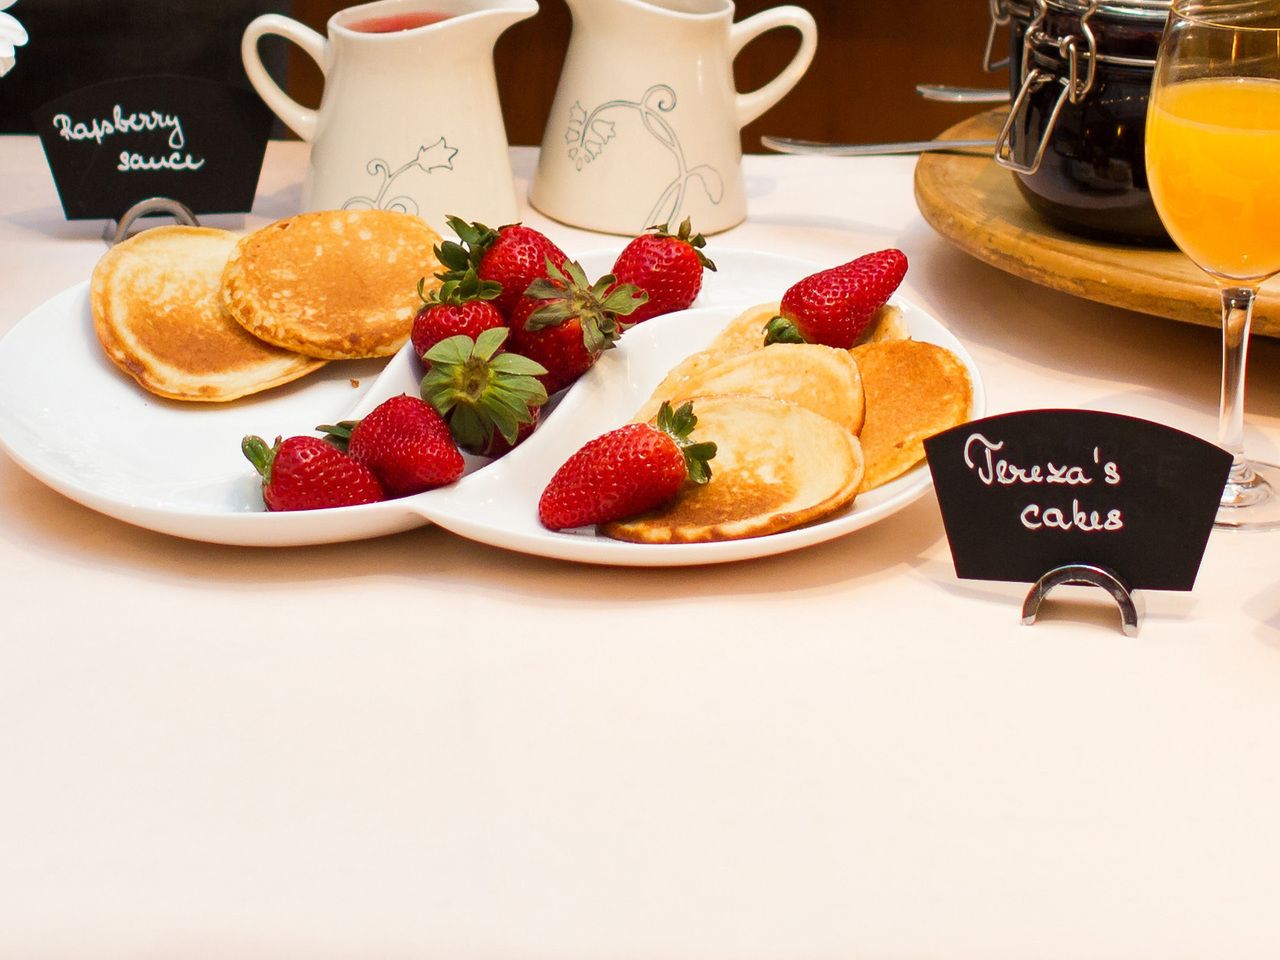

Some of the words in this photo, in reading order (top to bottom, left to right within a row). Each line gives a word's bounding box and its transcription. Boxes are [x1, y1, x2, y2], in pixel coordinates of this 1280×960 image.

[52, 104, 185, 149] Rapsberry
[116, 151, 206, 172] sauce
[963, 432, 1122, 486] Tereza's
[1019, 498, 1124, 532] cakes
